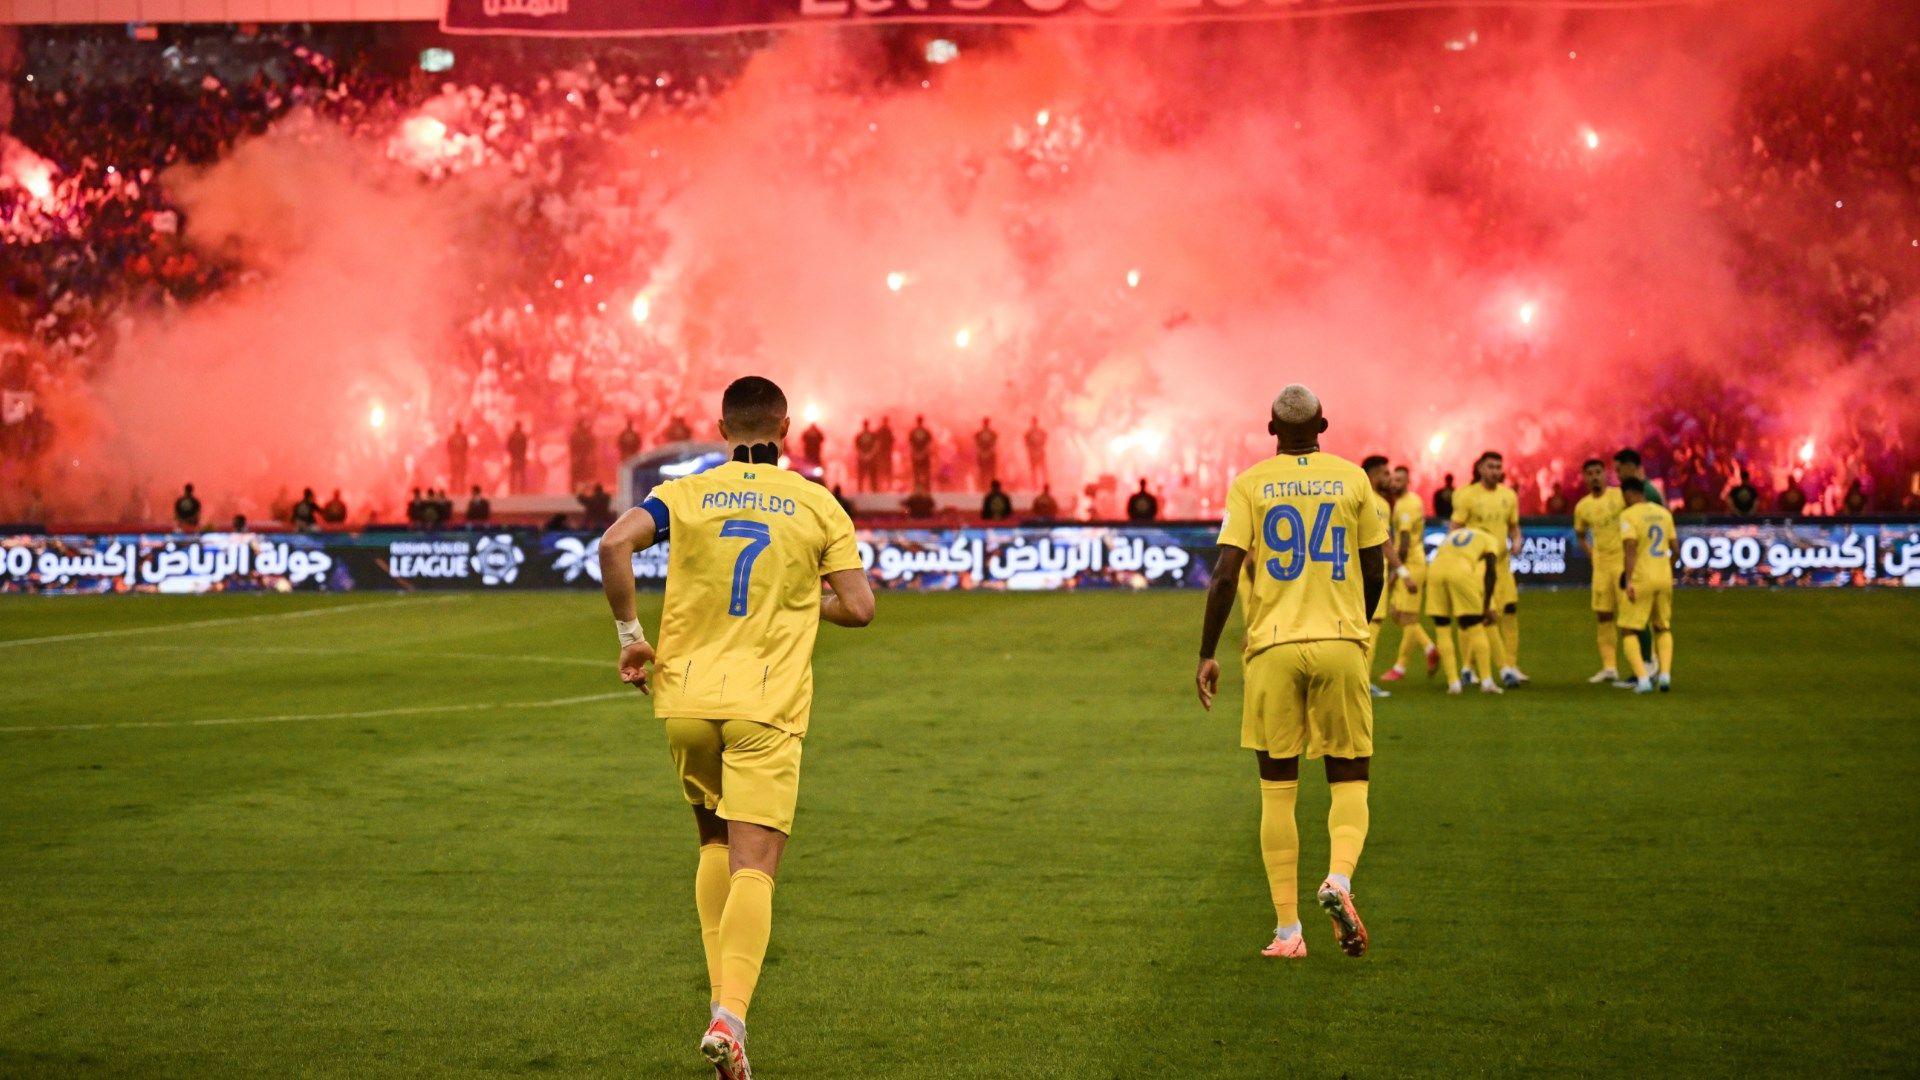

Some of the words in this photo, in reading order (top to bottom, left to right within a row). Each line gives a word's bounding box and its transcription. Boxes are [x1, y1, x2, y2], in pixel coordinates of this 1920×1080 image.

[702, 491, 796, 516] RONALDO
[1264, 480, 1344, 498] A.TALISCA
[989, 537, 1102, 579] الرياض
[1108, 537, 1190, 579] جولة
[1263, 503, 1349, 581] 94
[1647, 524, 1665, 557] 2
[1675, 536, 1760, 569] 030
[141, 543, 250, 583] الرياض
[255, 541, 332, 583] جولة
[389, 555, 468, 577] LEAGUE
[719, 519, 771, 617] 7
